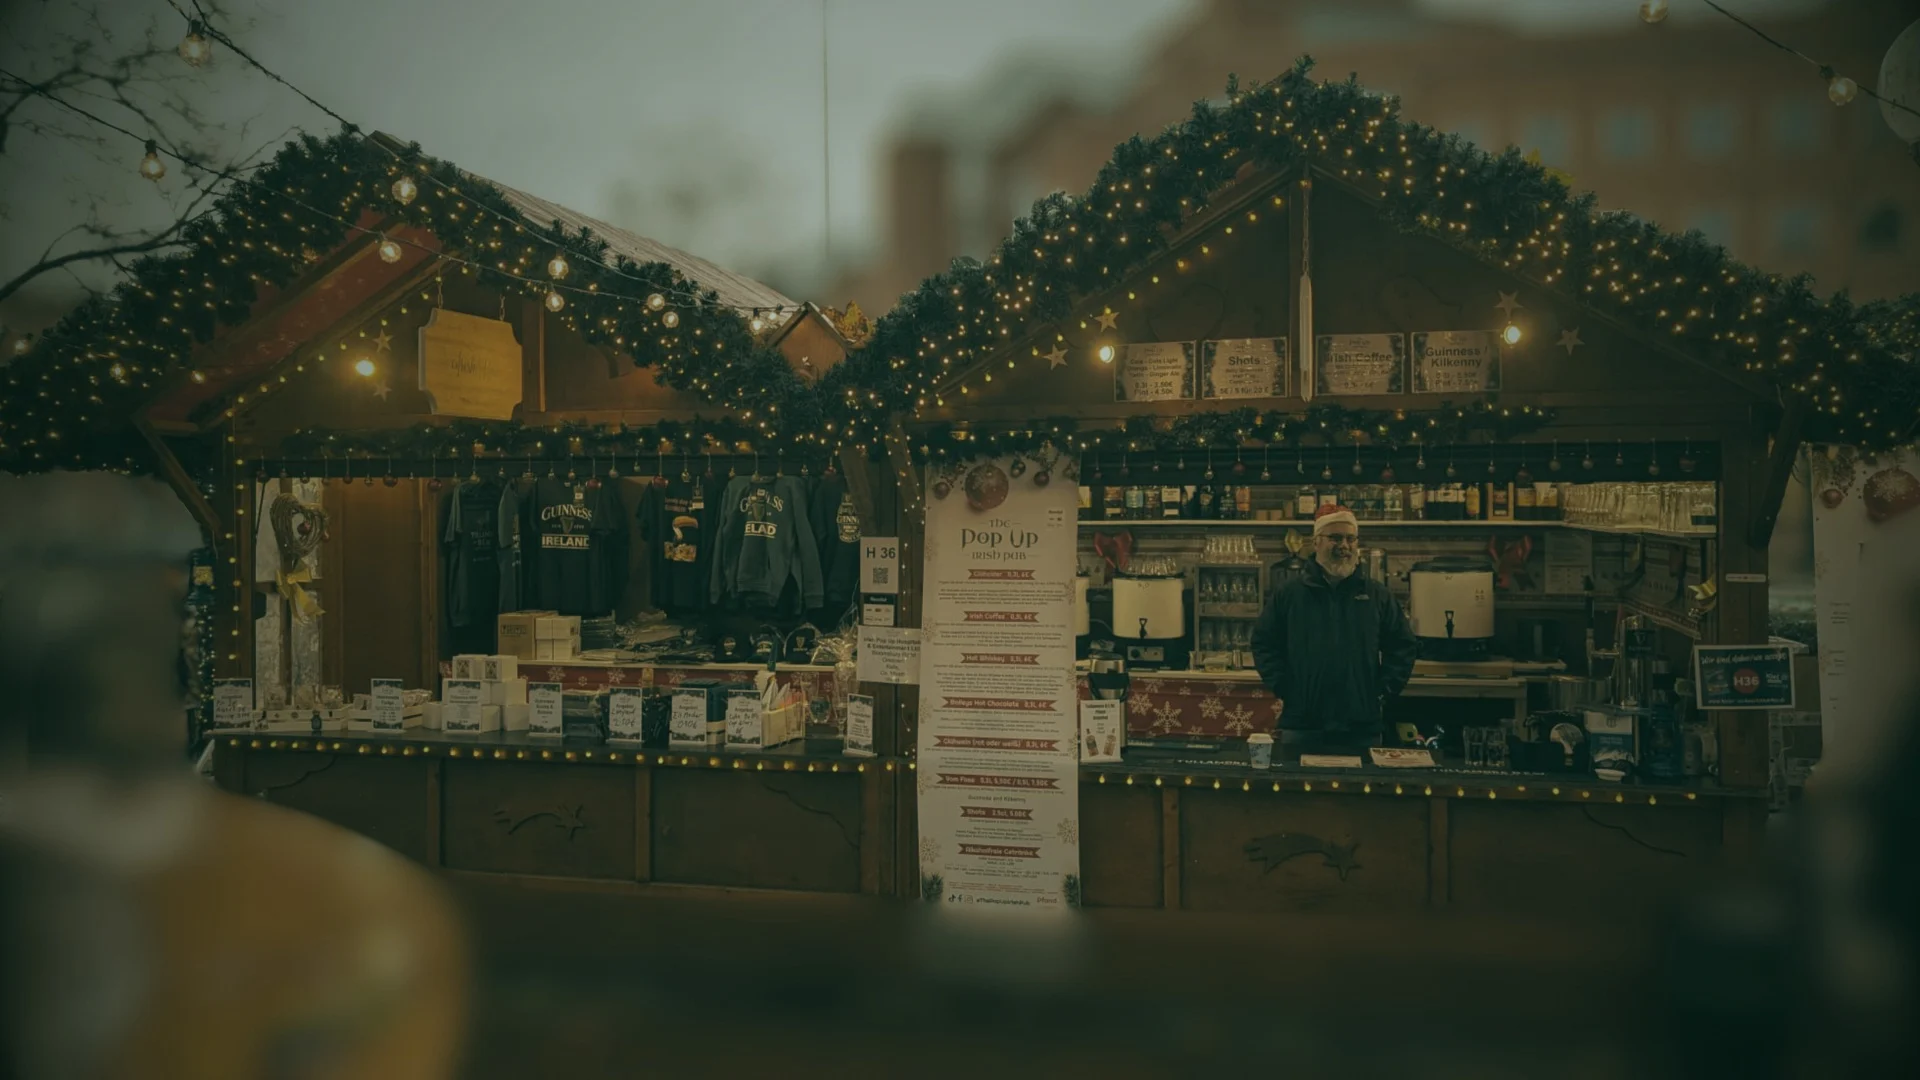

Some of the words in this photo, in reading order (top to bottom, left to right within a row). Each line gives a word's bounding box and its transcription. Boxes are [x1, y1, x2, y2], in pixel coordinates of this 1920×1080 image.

[1355, 350, 1392, 362] Coffee
[1426, 346, 1480, 357] Guinness
[1228, 356, 1261, 366] Shots
[1431, 358, 1482, 368] Kilkenny
[962, 528, 1002, 550] Pop
[866, 547, 876, 558] H
[880, 547, 896, 559] 36
[1733, 676, 1760, 687] H36
